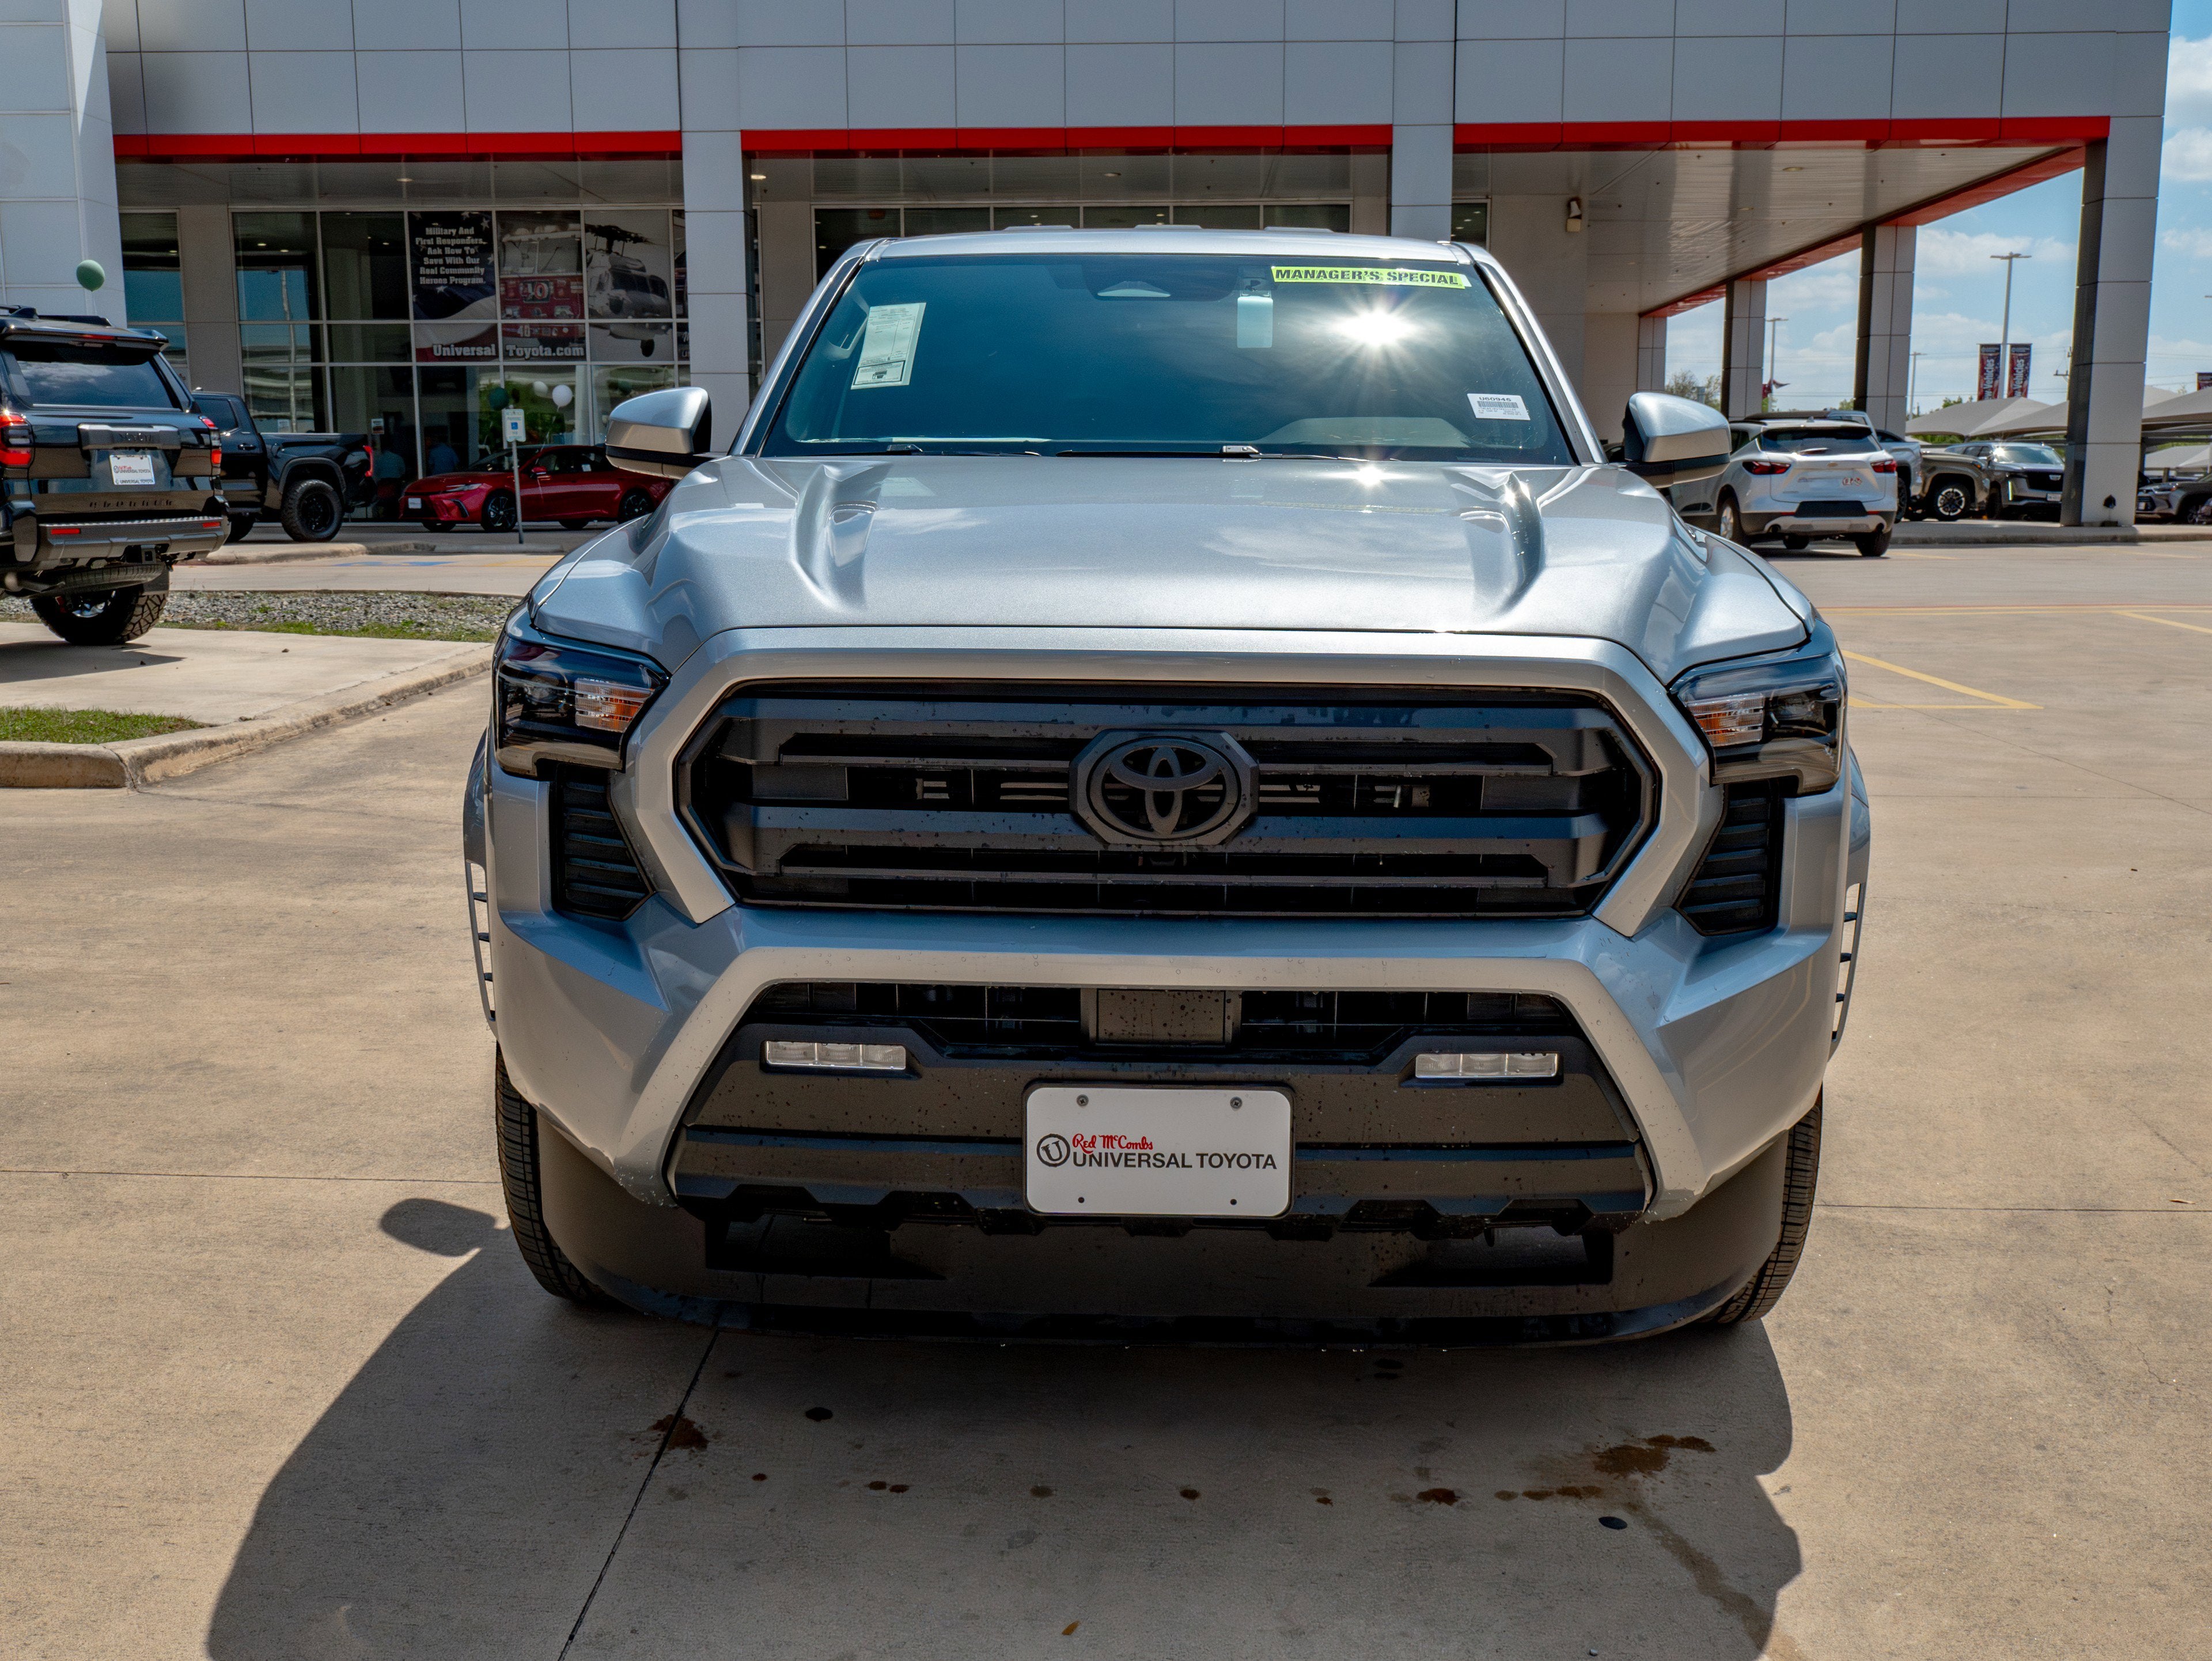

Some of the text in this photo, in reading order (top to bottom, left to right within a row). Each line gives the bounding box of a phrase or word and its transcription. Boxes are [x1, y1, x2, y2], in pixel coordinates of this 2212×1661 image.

[426, 226, 474, 236] Military And
[415, 237, 434, 245] First
[464, 247, 475, 255] To
[440, 266, 485, 275] Community
[1275, 268, 1459, 285] MANAGER'S SPECIAL
[433, 343, 585, 359] Universal Toyota.com
[1983, 359, 1994, 389] Vehicles
[2013, 359, 2024, 389] Vehicles
[1072, 1133, 1153, 1154] Red McCombs
[1073, 1151, 1277, 1170] UNIVERSAL TOYOTA
